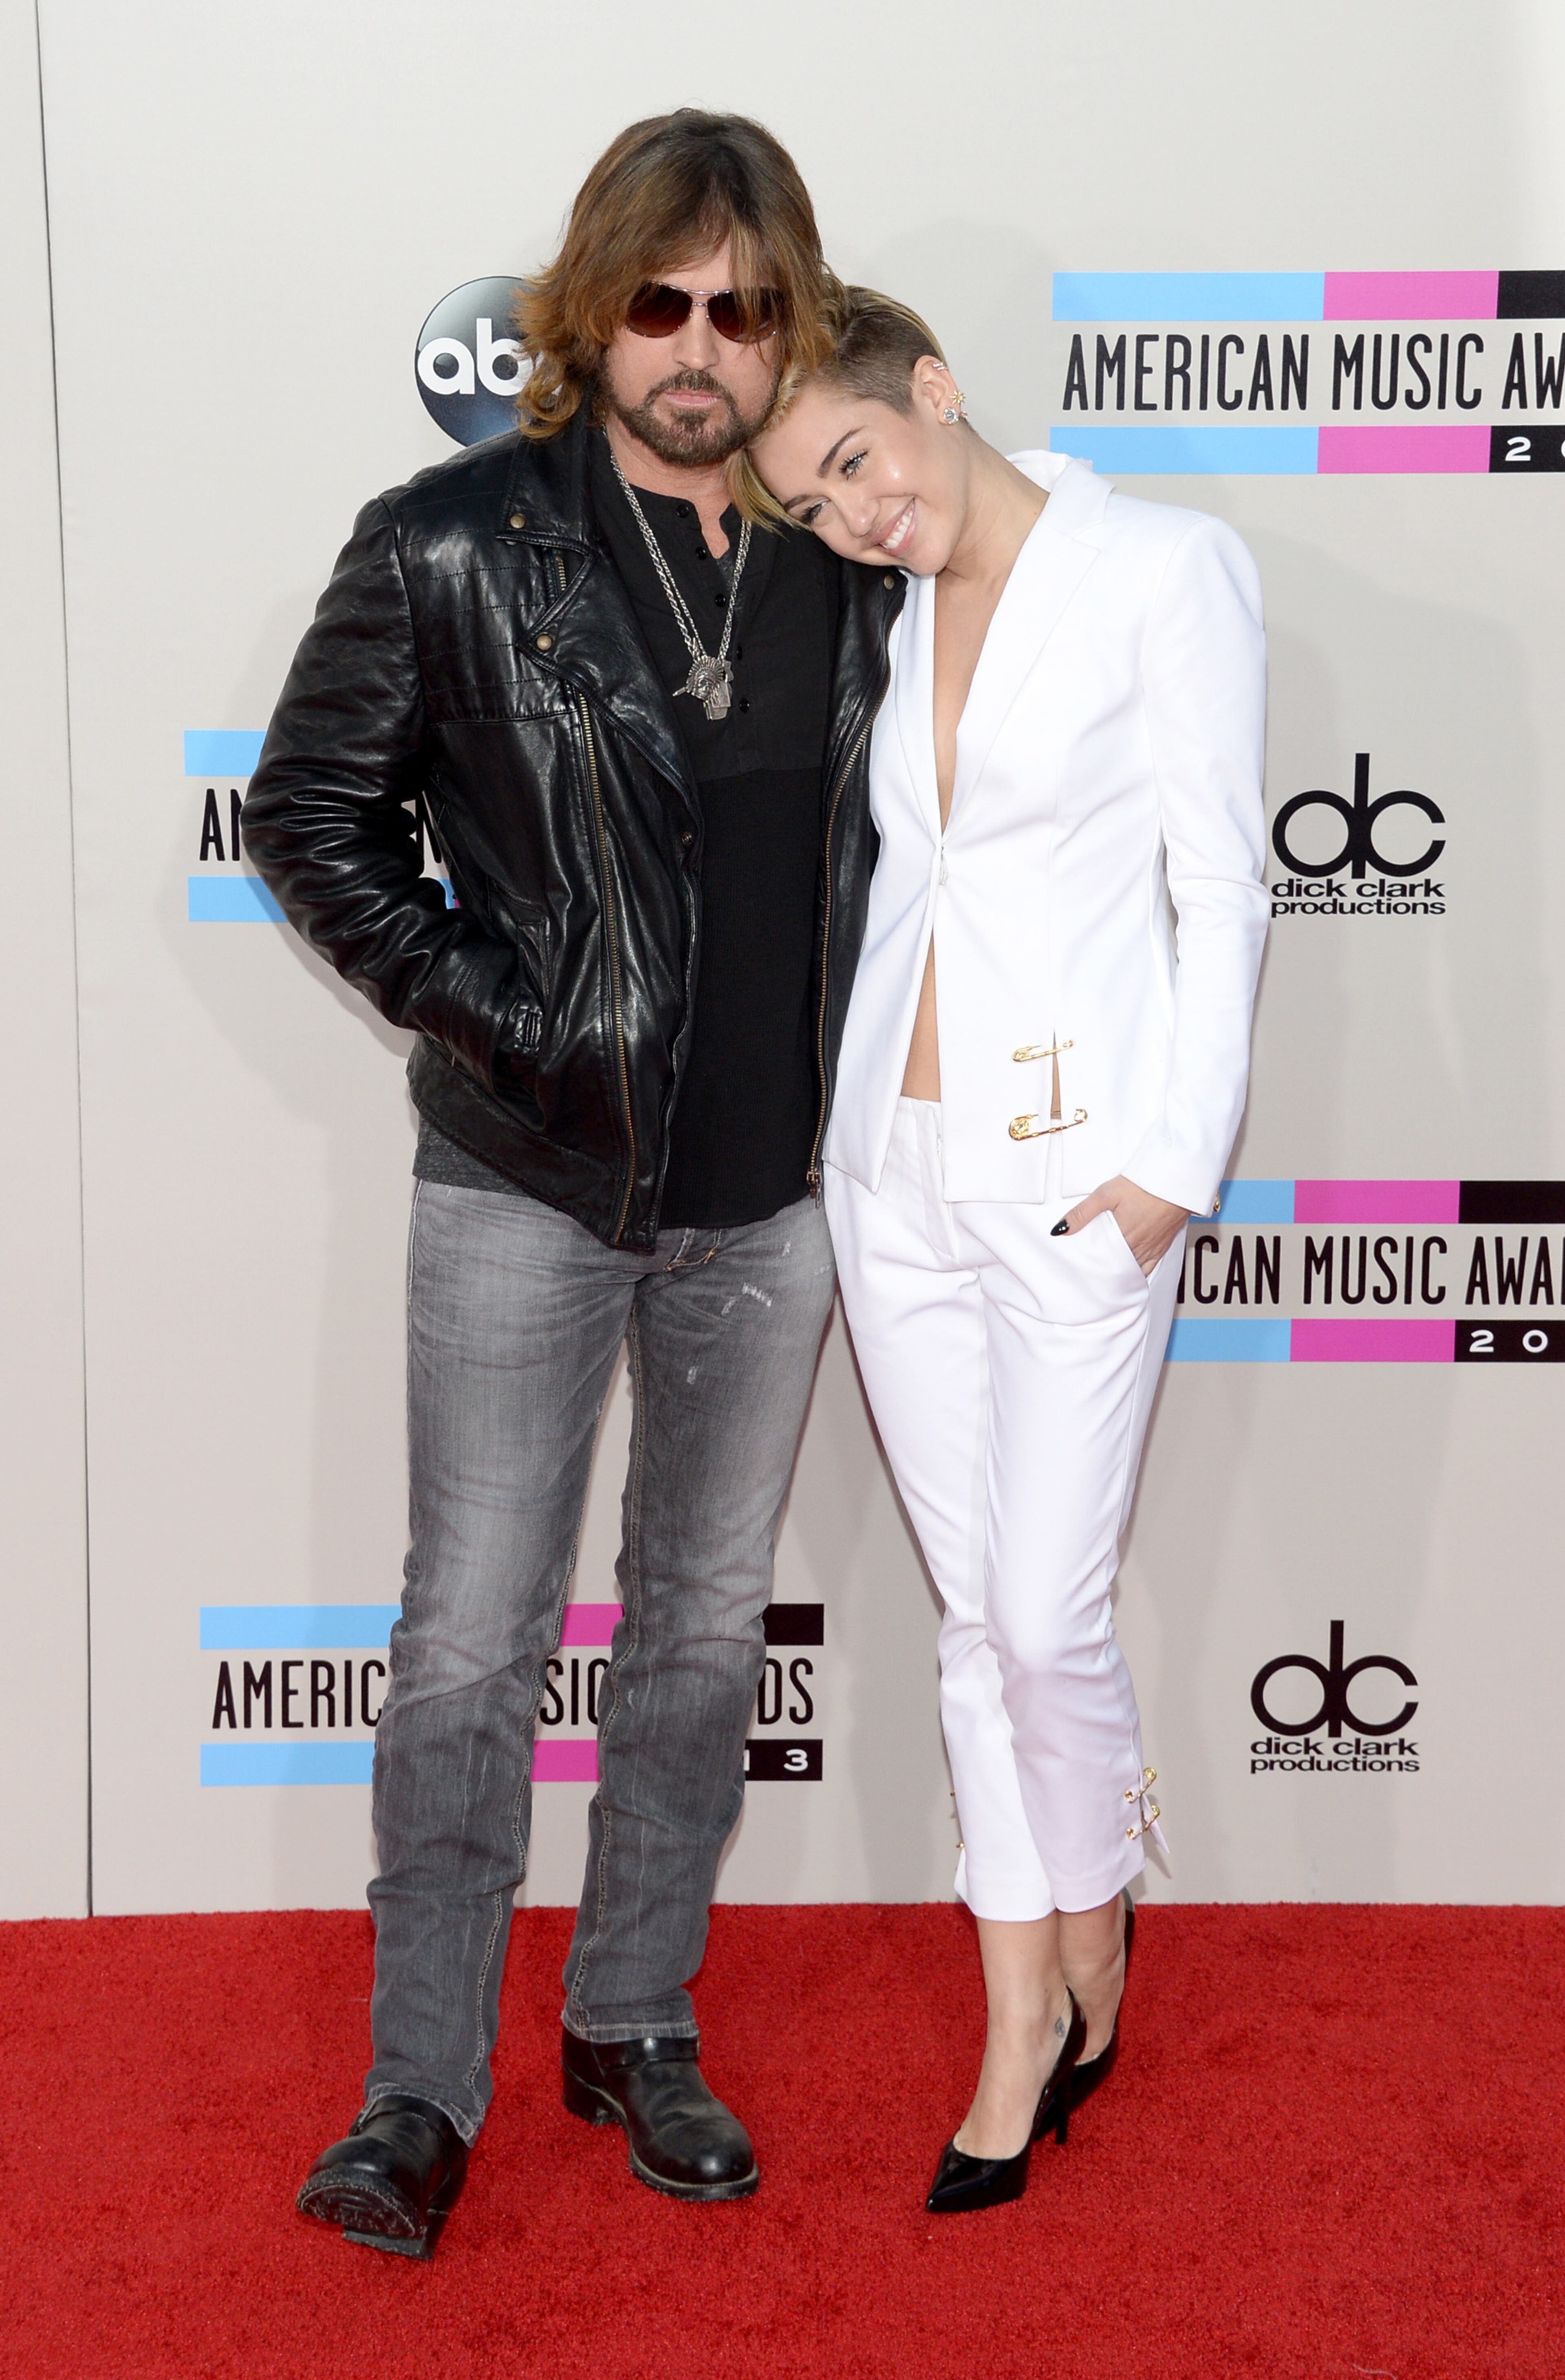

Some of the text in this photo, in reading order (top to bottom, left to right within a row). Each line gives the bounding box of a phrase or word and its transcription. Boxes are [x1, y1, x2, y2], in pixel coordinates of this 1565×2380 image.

[418, 318, 546, 396] ab
[1062, 334, 1309, 410] AMERICAN
[1332, 333, 1484, 410] MUSIC
[1271, 879, 1445, 897] dick clark
[1271, 898, 1446, 918] productions
[1303, 1236, 1447, 1305] MUSIC
[1465, 1236, 1565, 1305] AWA
[212, 1660, 386, 1729] AMERIC
[1250, 1737, 1419, 1756] dick clark
[1250, 1756, 1420, 1774] productions
